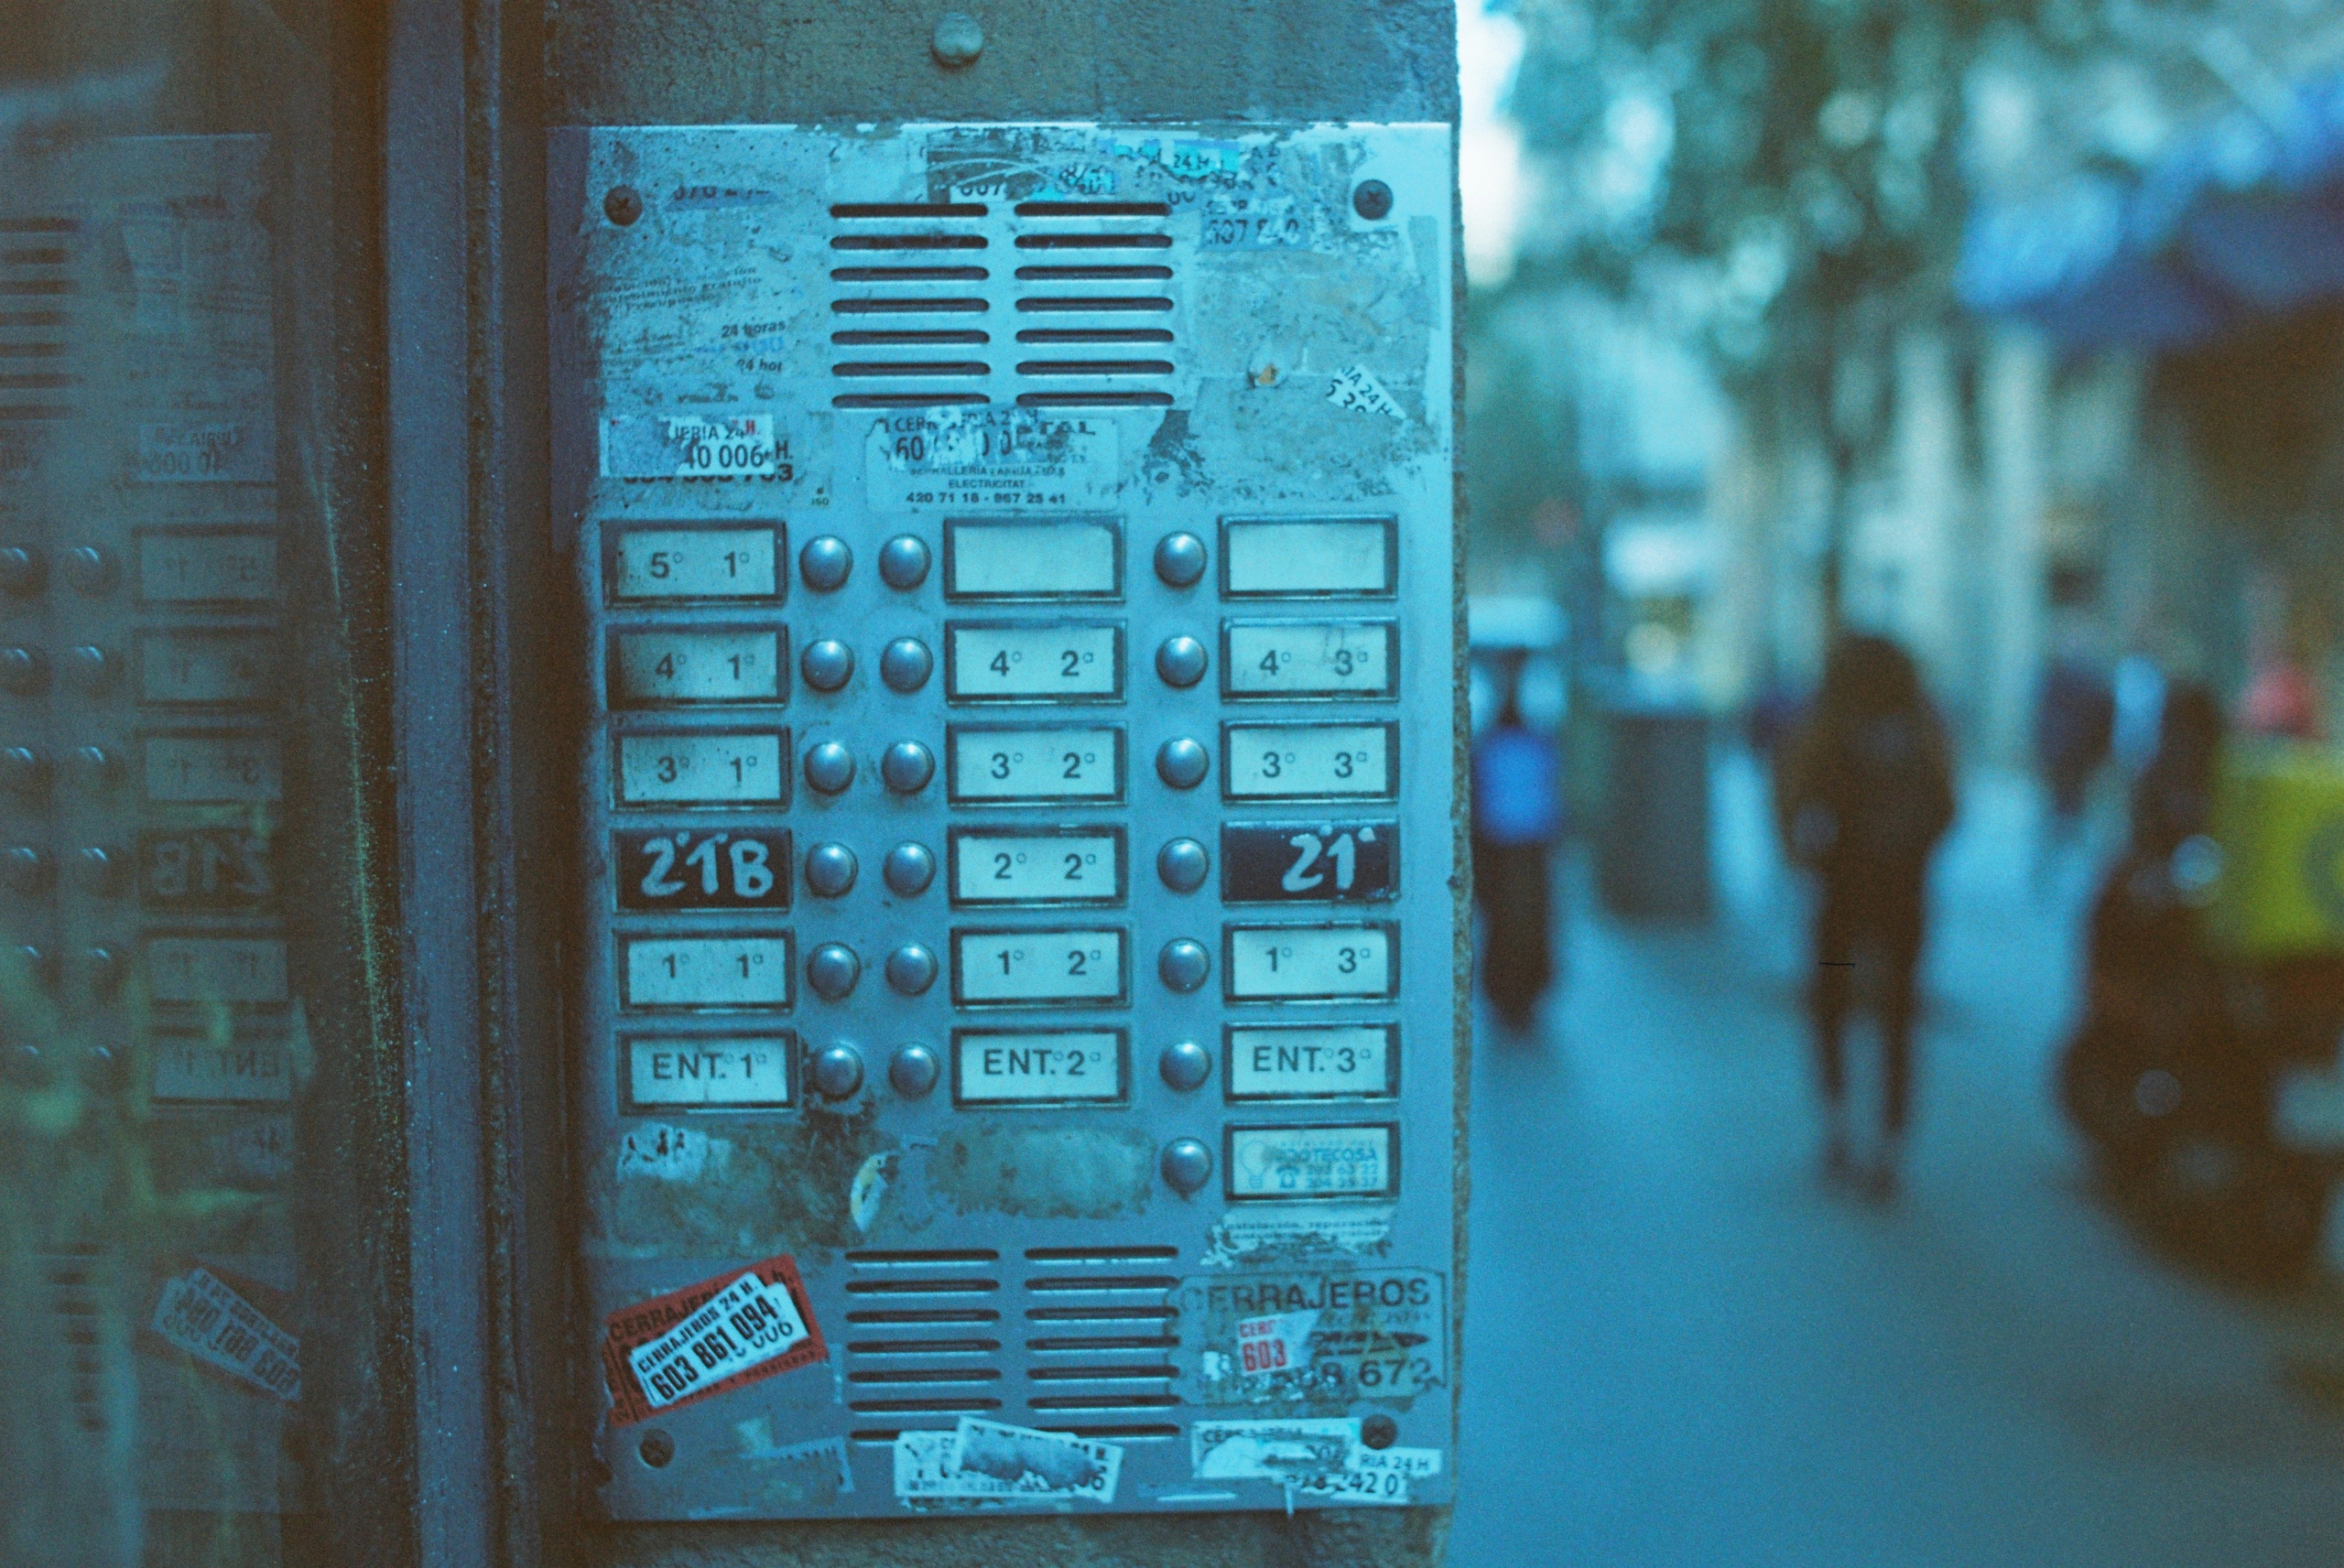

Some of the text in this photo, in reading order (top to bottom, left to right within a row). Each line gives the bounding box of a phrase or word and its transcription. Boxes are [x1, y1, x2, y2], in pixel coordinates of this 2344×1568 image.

[649, 1354, 700, 1401] 603
[691, 1325, 738, 1369] 861
[730, 1294, 779, 1340] 094
[1242, 1338, 1287, 1372] 603
